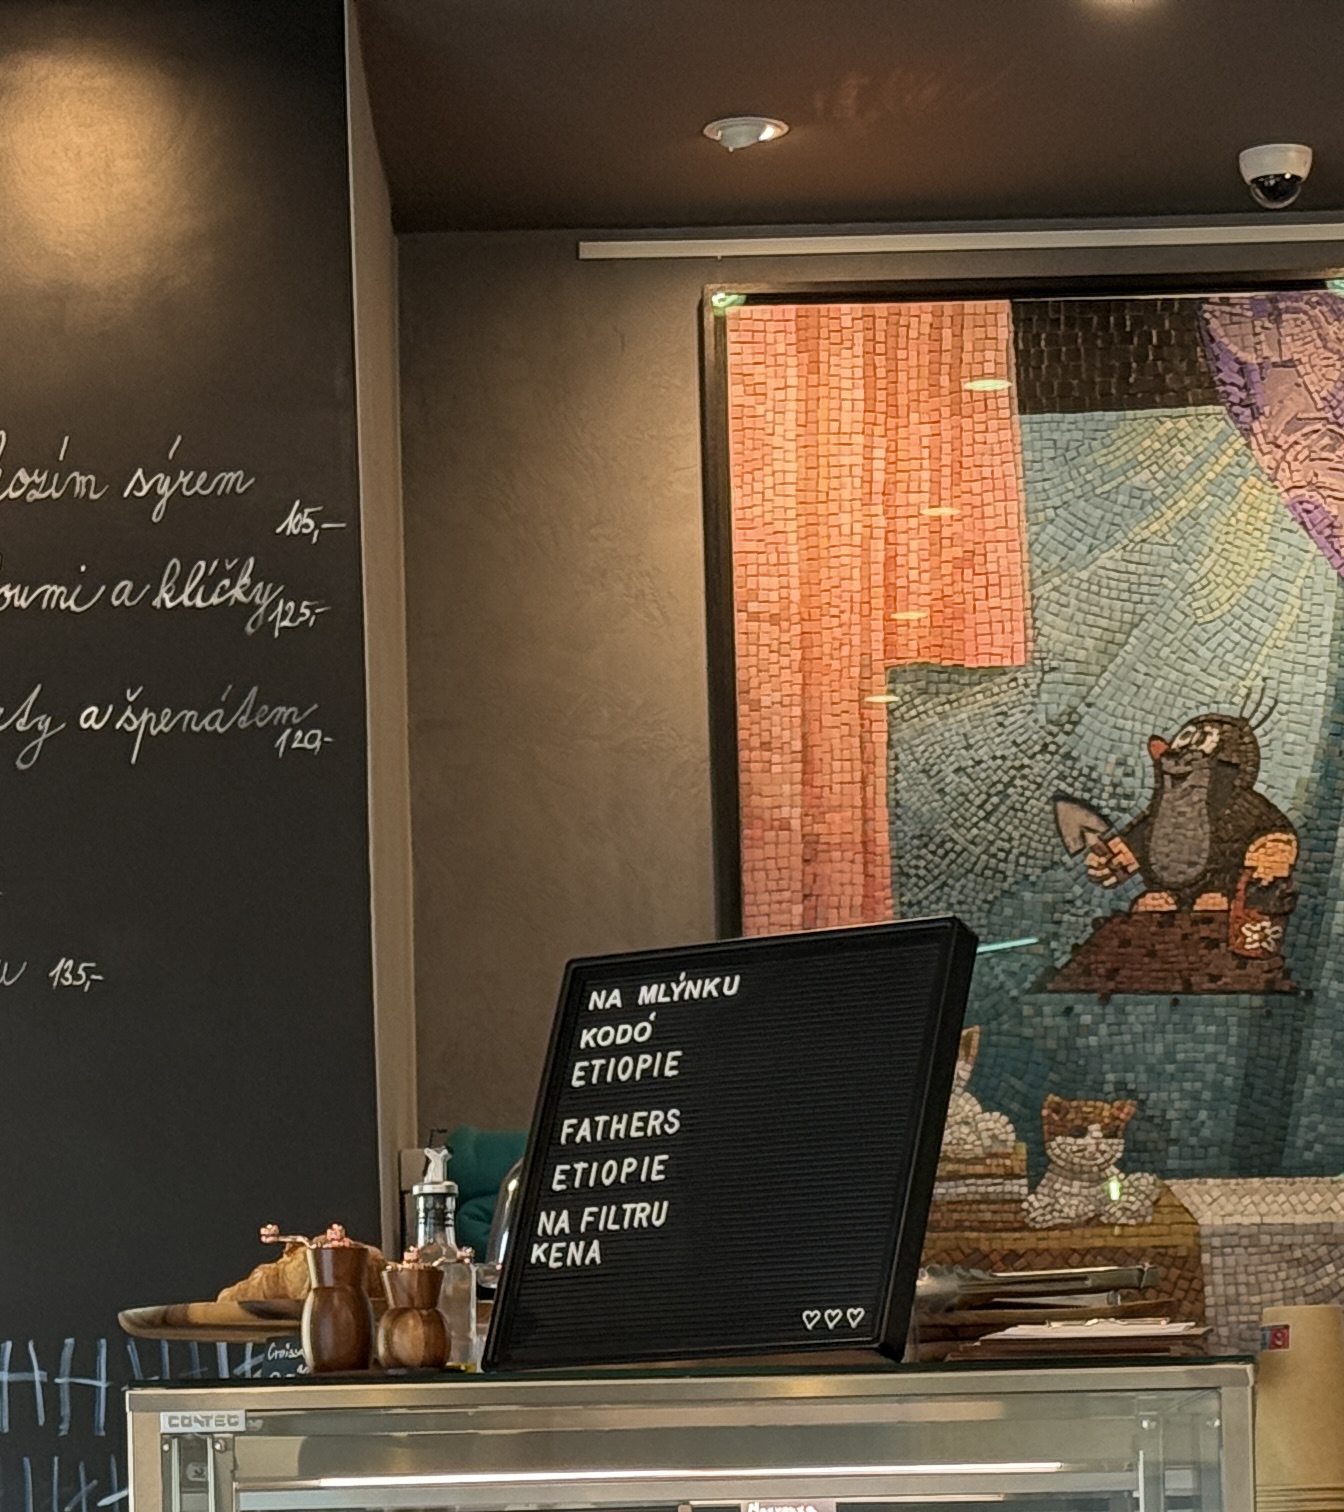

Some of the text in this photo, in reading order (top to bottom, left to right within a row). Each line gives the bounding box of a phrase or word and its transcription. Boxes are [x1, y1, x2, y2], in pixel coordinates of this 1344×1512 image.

[123, 435, 255, 521] sýrem
[112, 580, 150, 609] a
[152, 556, 283, 634] klíčky
[79, 700, 114, 730] a
[116, 683, 318, 765] špenátem
[588, 972, 741, 1011] NA MLÝNKU
[570, 1050, 683, 1088] ETIOPIE
[560, 1109, 681, 1145] FATHERS
[552, 1155, 670, 1192] ETIOPIE
[537, 1201, 669, 1237] NA FILTRU
[530, 1240, 602, 1269] KENA
